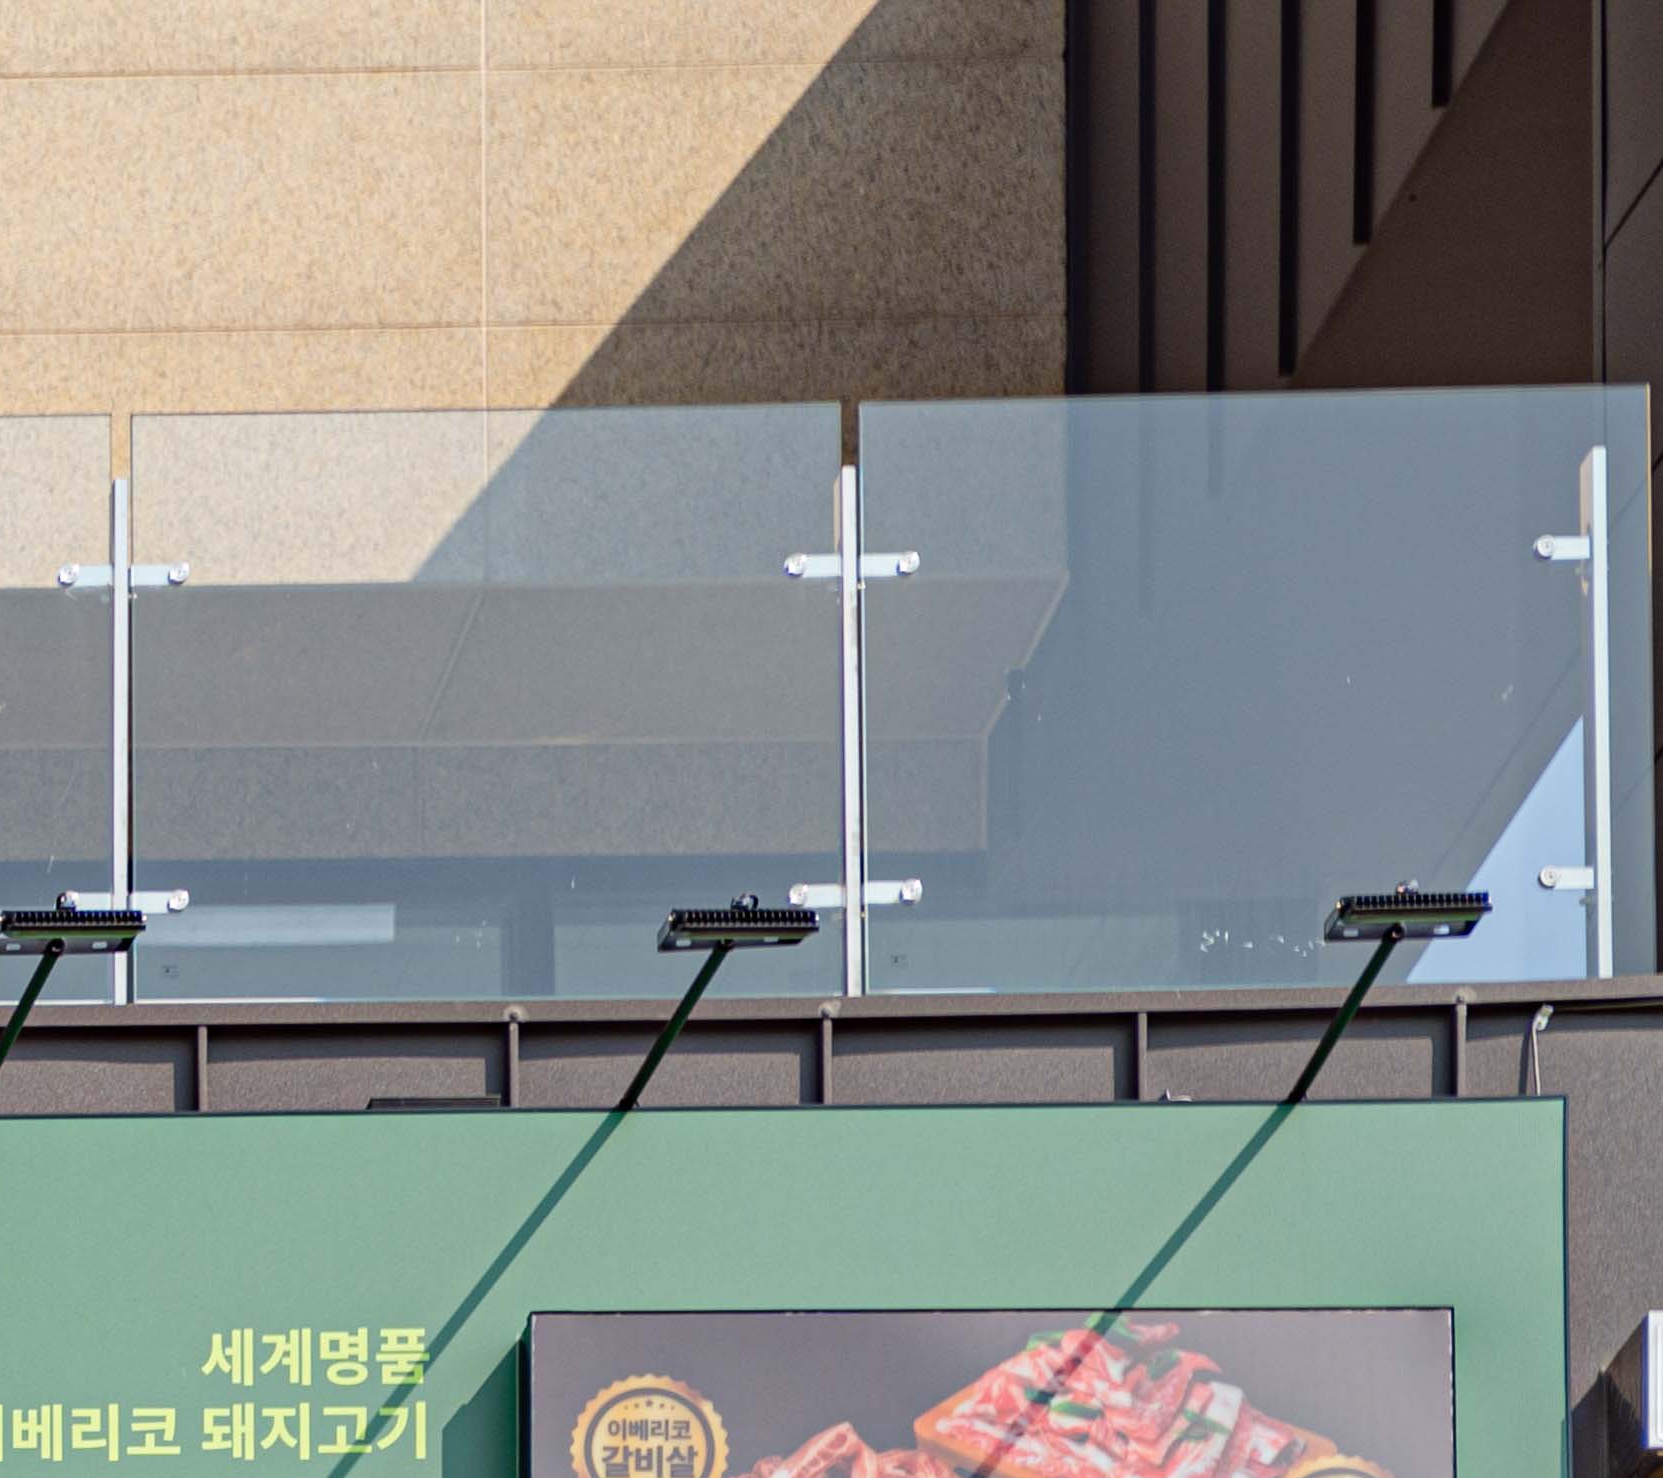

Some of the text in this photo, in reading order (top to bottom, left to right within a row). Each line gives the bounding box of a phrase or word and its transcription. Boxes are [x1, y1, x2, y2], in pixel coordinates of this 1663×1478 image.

[201, 1327, 430, 1387] 세계명품
[201, 1400, 427, 1463] 돼지고기
[607, 1418, 692, 1441] 이베리코
